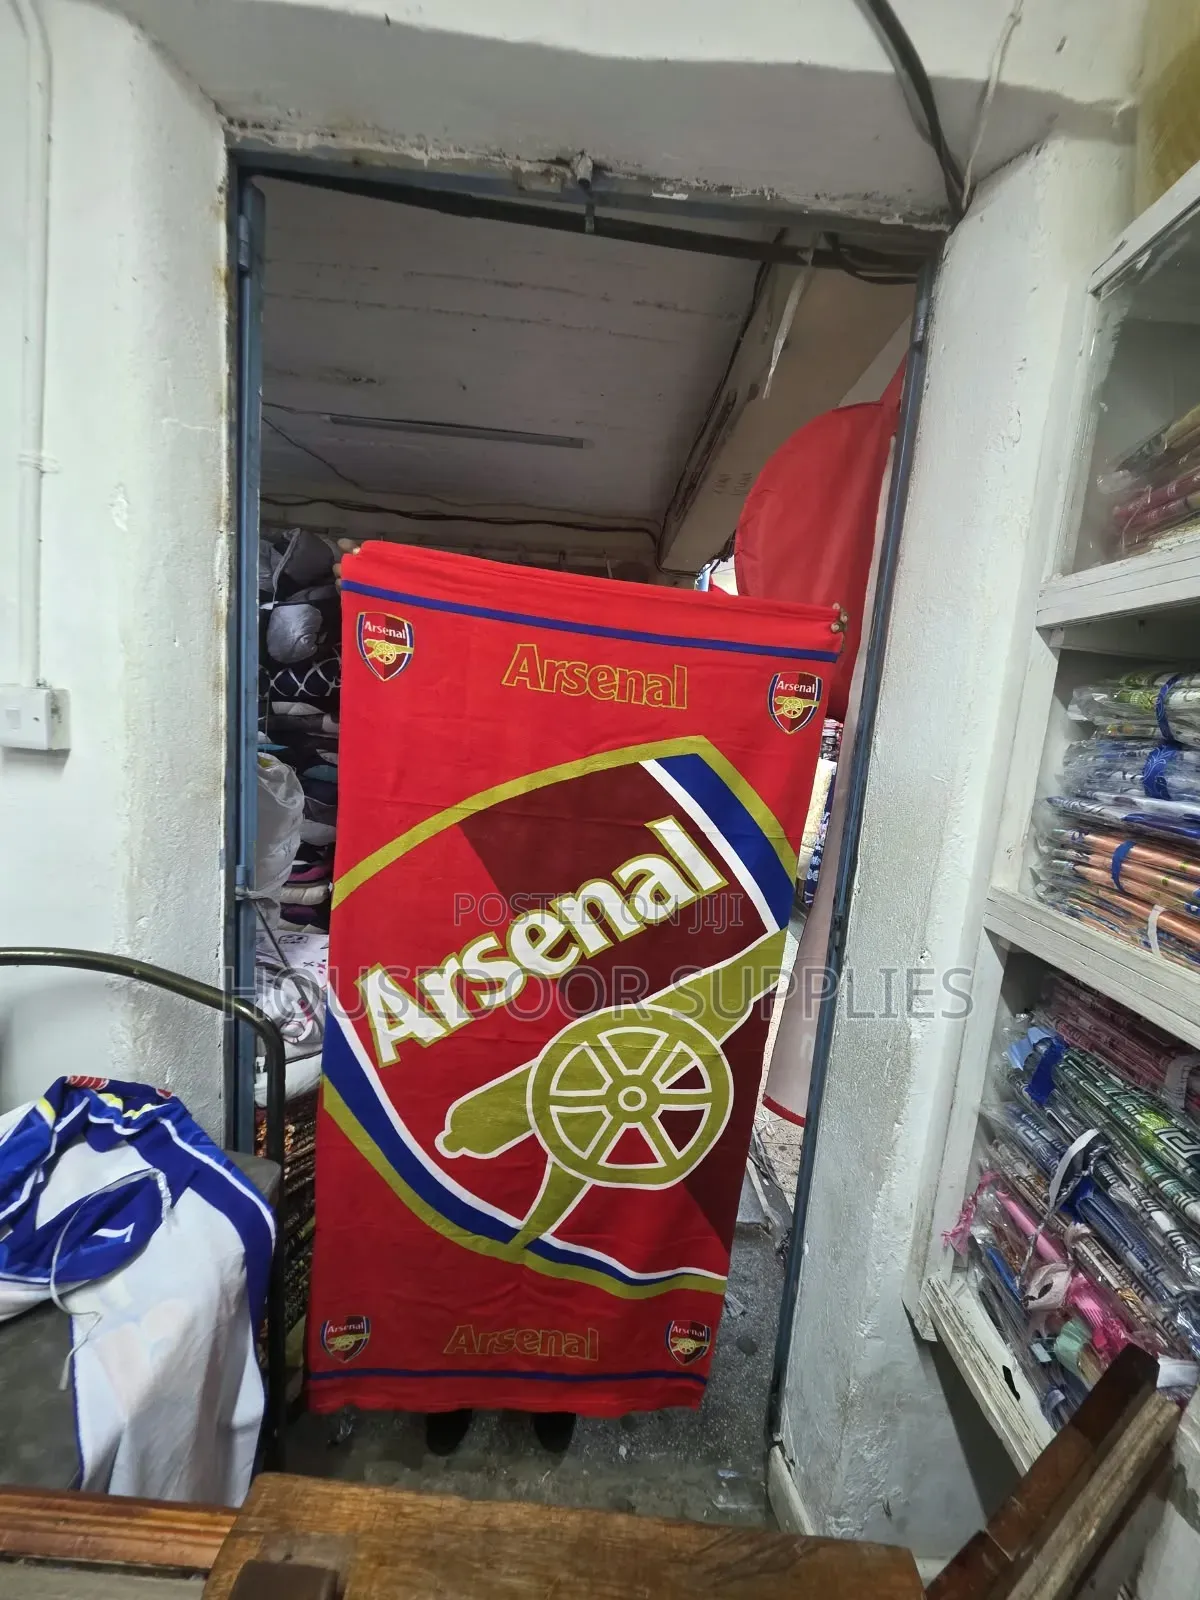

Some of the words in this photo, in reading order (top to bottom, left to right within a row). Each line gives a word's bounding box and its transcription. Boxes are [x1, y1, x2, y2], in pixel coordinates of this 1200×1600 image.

[364, 621, 406, 640] Arsenal
[501, 643, 686, 710] Arsenal
[776, 680, 816, 694] Arsenal
[355, 815, 729, 1068] Arsenal
[327, 1321, 365, 1335] Arsenal
[671, 1325, 706, 1337] Arsenal
[443, 1324, 599, 1362] Arsenal
